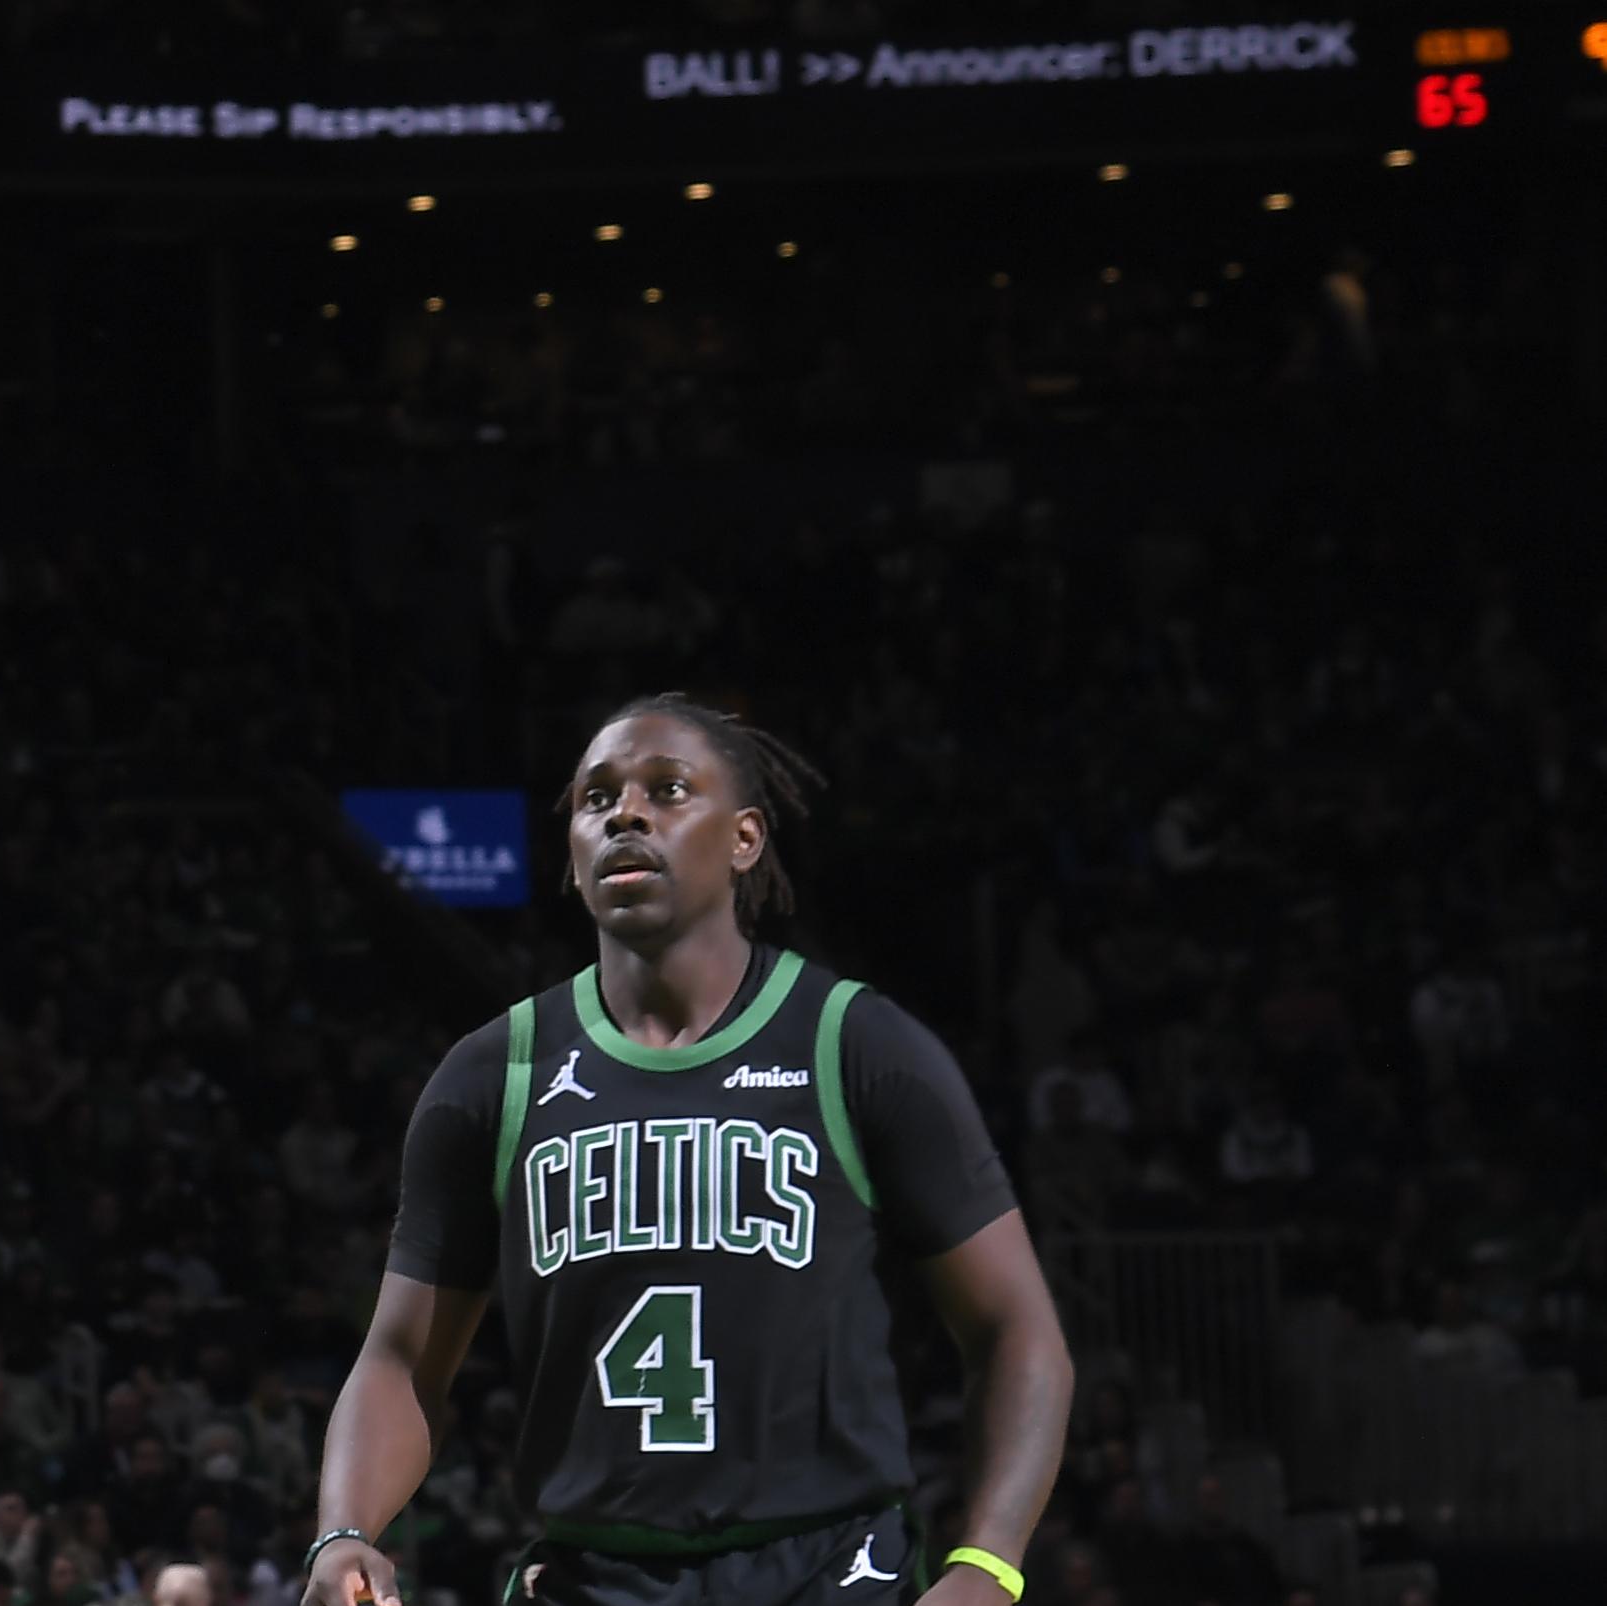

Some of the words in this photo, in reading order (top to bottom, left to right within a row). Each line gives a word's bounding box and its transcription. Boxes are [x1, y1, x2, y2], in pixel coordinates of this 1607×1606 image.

[644, 50, 779, 99] BALL!
[1129, 22, 1357, 77] DERRICK
[1416, 73, 1488, 128] 65
[722, 1063, 809, 1089] Amica
[524, 1116, 819, 1278] CELTICS
[594, 1284, 716, 1453] 4
